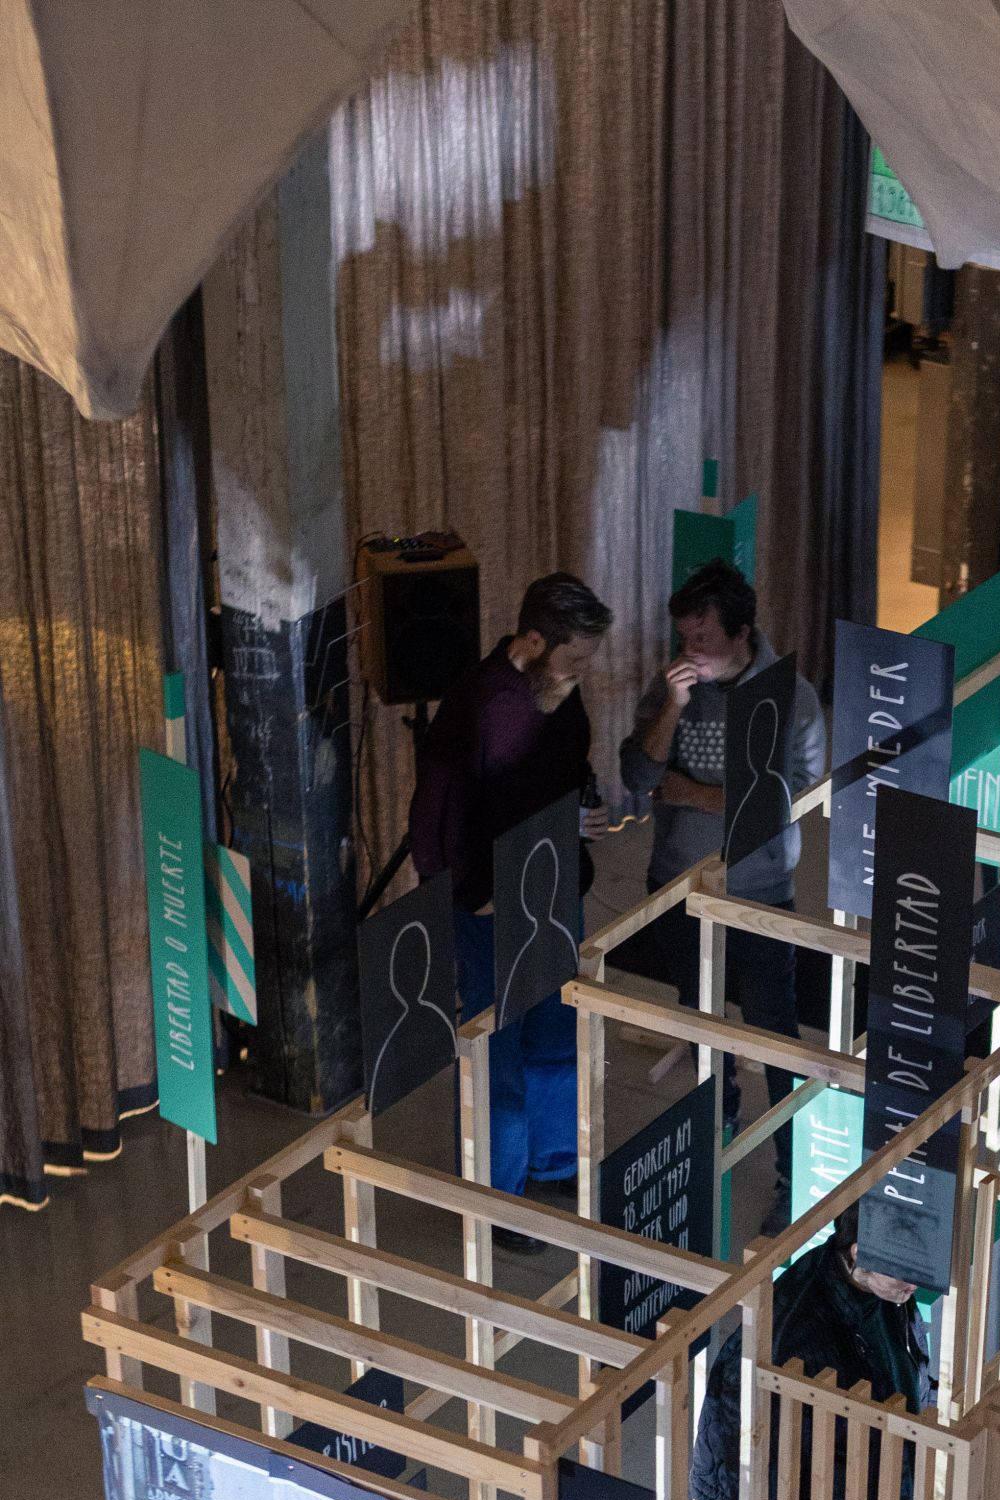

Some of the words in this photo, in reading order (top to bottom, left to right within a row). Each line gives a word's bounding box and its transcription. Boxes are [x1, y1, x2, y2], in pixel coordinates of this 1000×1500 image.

[158, 831, 186, 929] MUERTE
[890, 872, 942, 1036] LIBERTAD
[164, 961, 195, 1071] LIBERTAD
[887, 1045, 934, 1091] DE
[623, 1142, 671, 1197] GEBOREN
[675, 1117, 692, 1157] AM
[640, 1177, 665, 1220] JULI
[666, 1157, 691, 1199] 1979
[668, 1193, 689, 1232] UND
